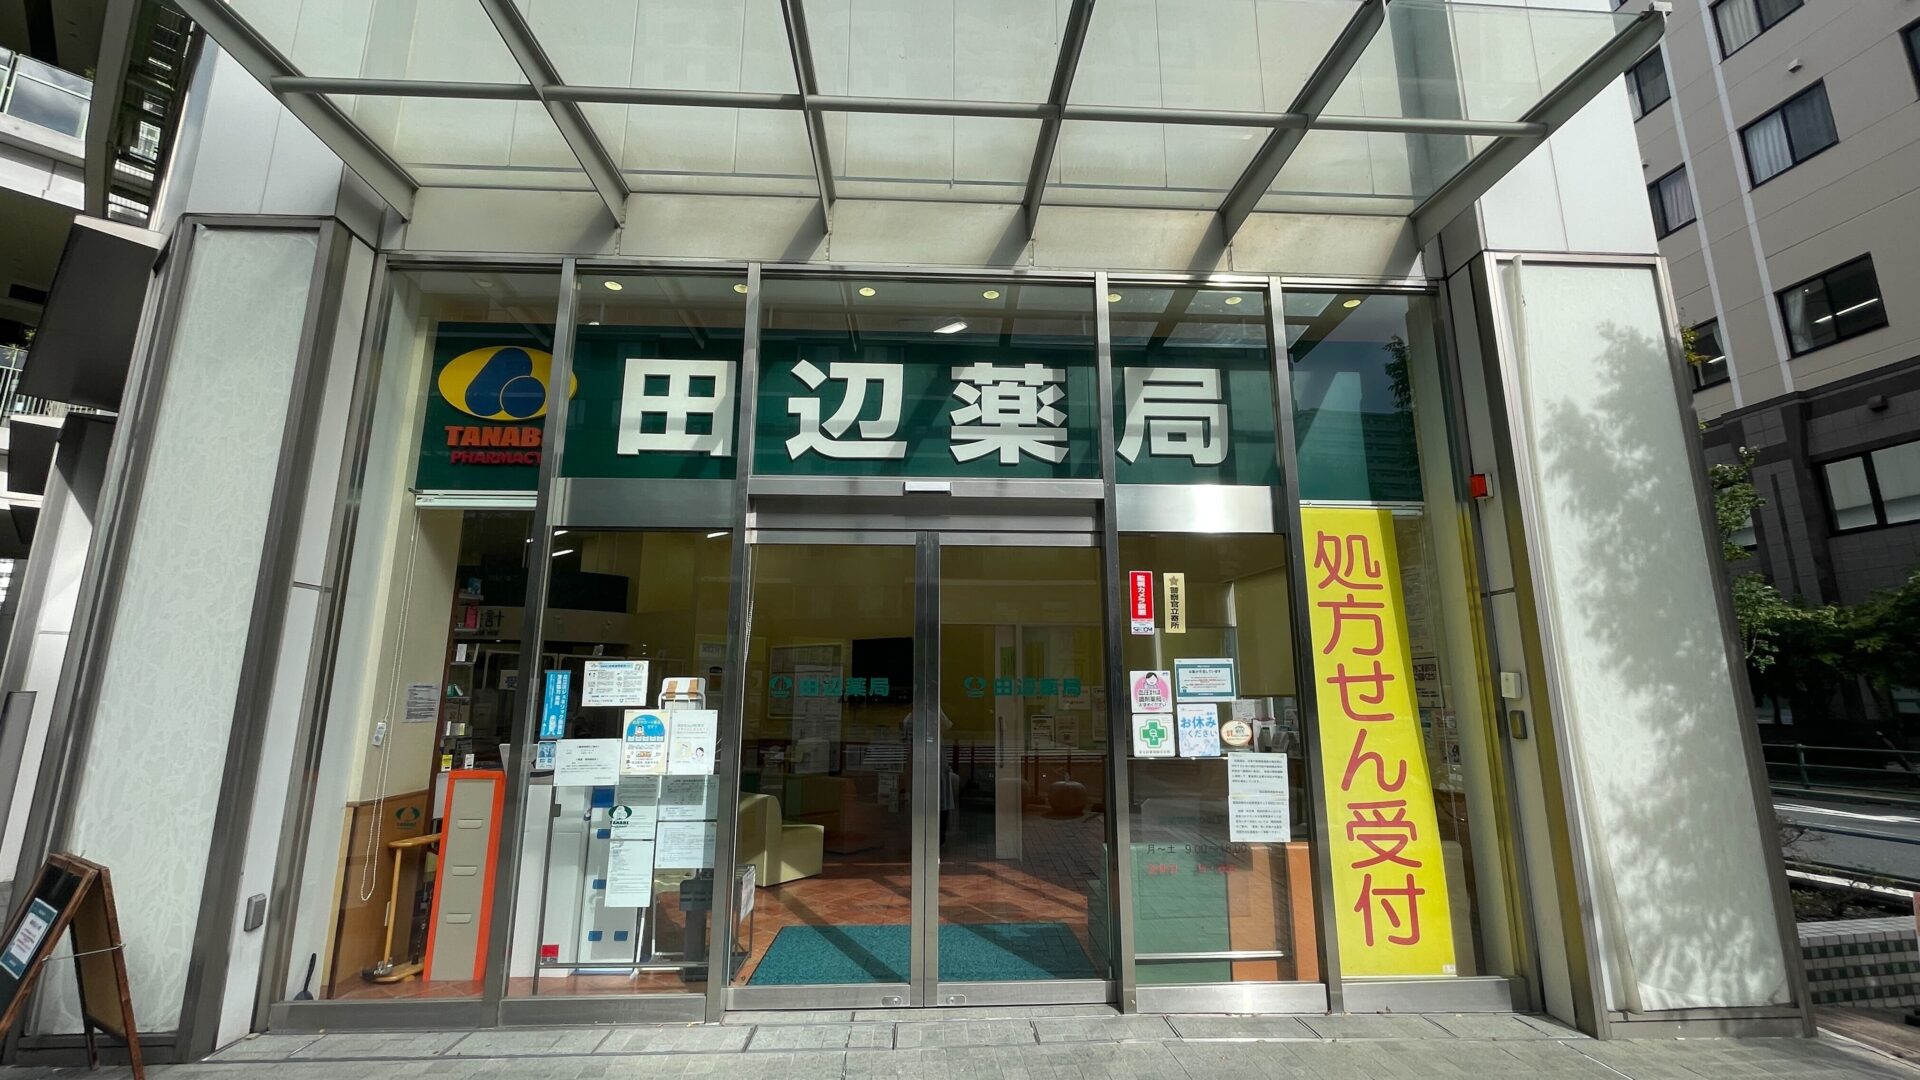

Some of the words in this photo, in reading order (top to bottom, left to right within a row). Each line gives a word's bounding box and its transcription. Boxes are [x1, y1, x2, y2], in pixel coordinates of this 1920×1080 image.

[617, 357, 1229, 466] 田辺薬局
[445, 426, 541, 446] TANAB
[800, 677, 889, 697] 田辺薬局
[993, 677, 1081, 697] 田辺薬局
[1181, 716, 1216, 729] お休み
[1188, 730, 1217, 738] ください
[1315, 530, 1425, 946] 処方せん受付
